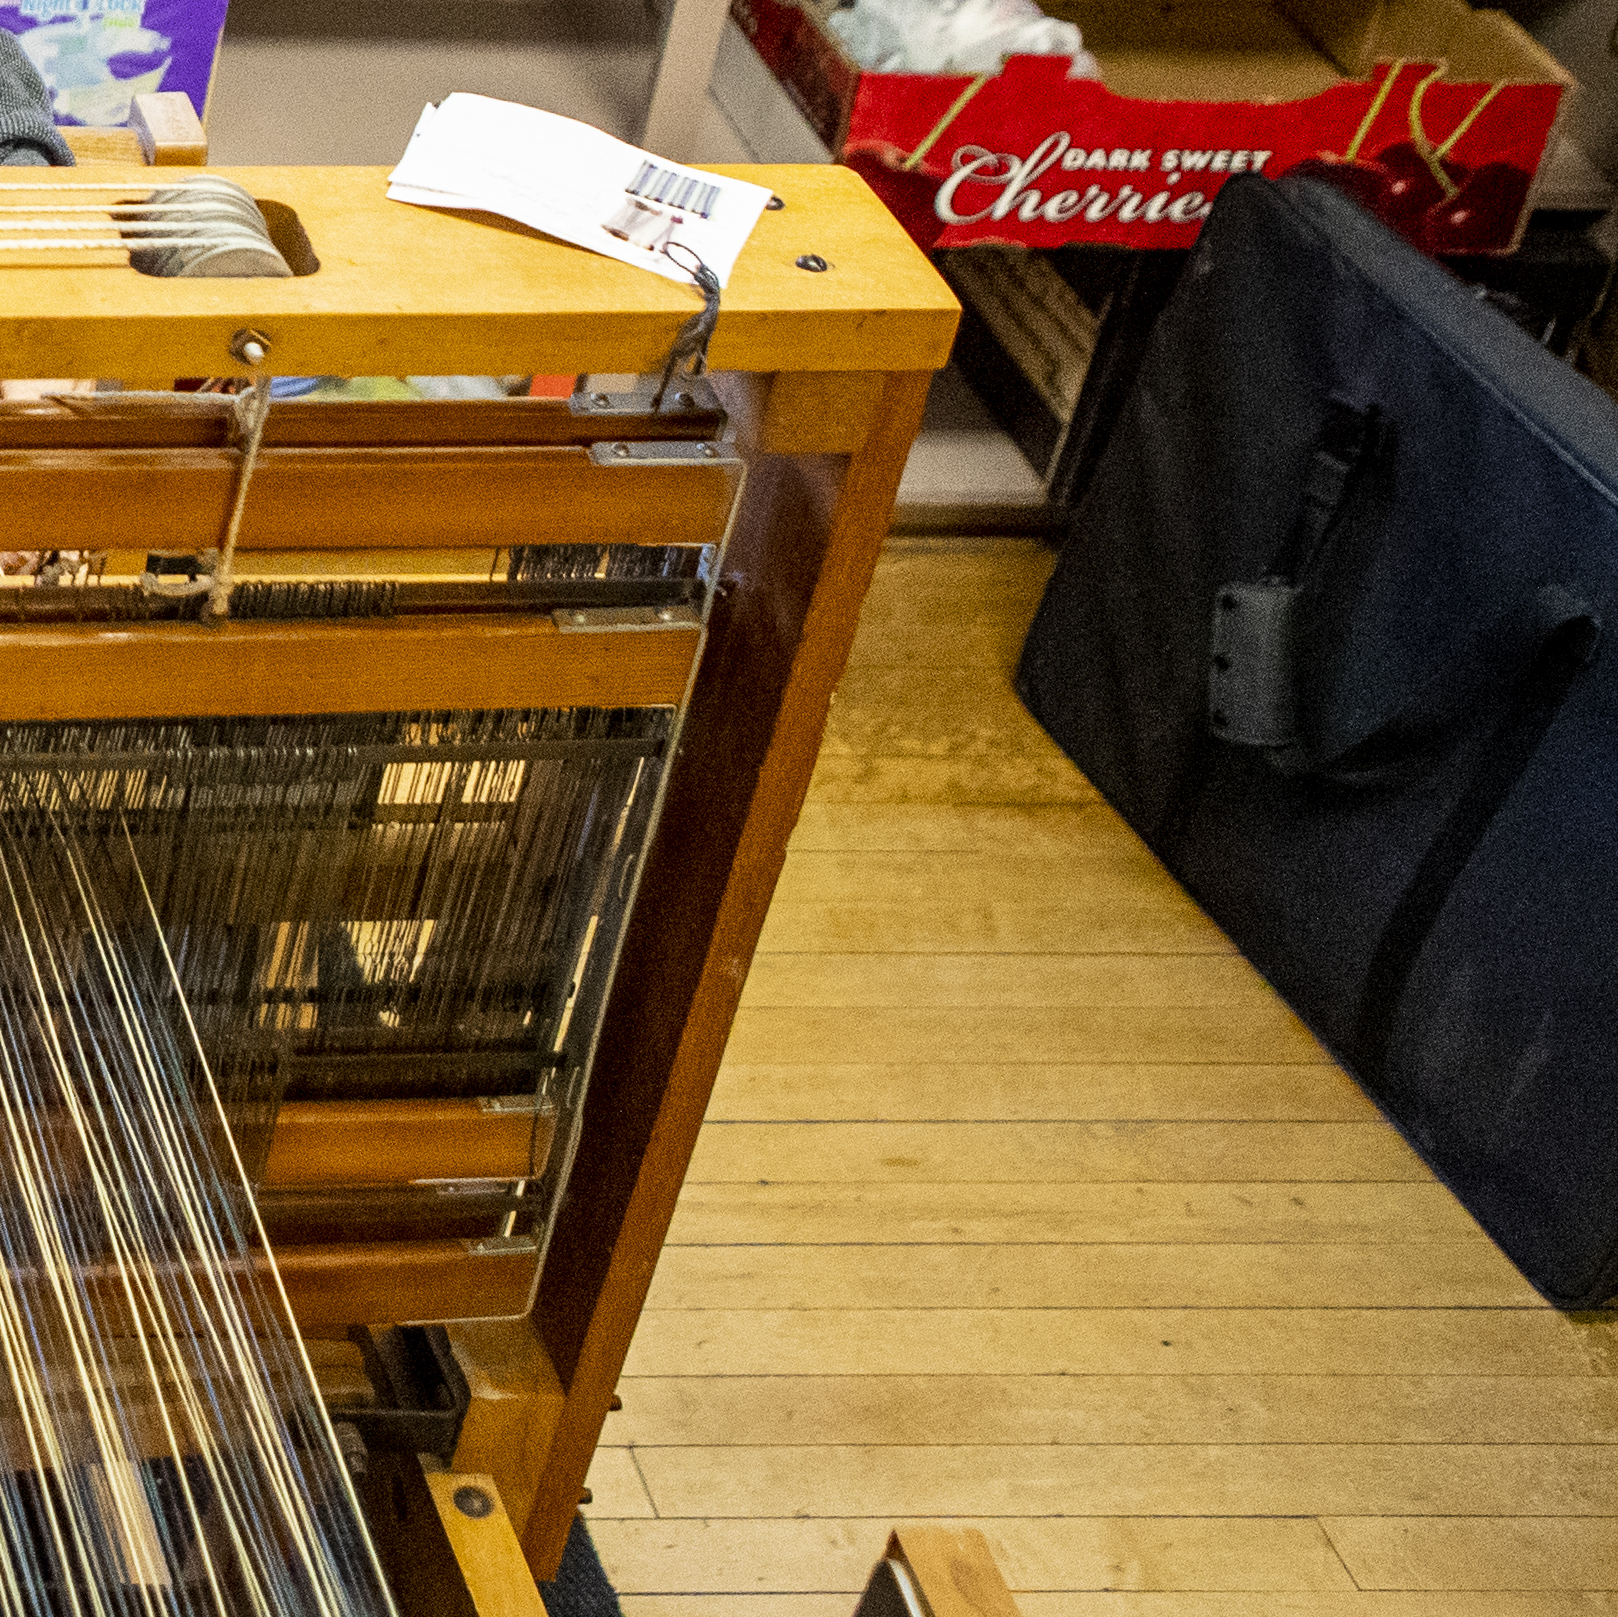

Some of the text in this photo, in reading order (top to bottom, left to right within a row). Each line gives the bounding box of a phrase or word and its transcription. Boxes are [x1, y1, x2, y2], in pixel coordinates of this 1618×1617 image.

[934, 131, 1214, 225] Cherrie
[1060, 148, 1273, 172] DARK SWEET
